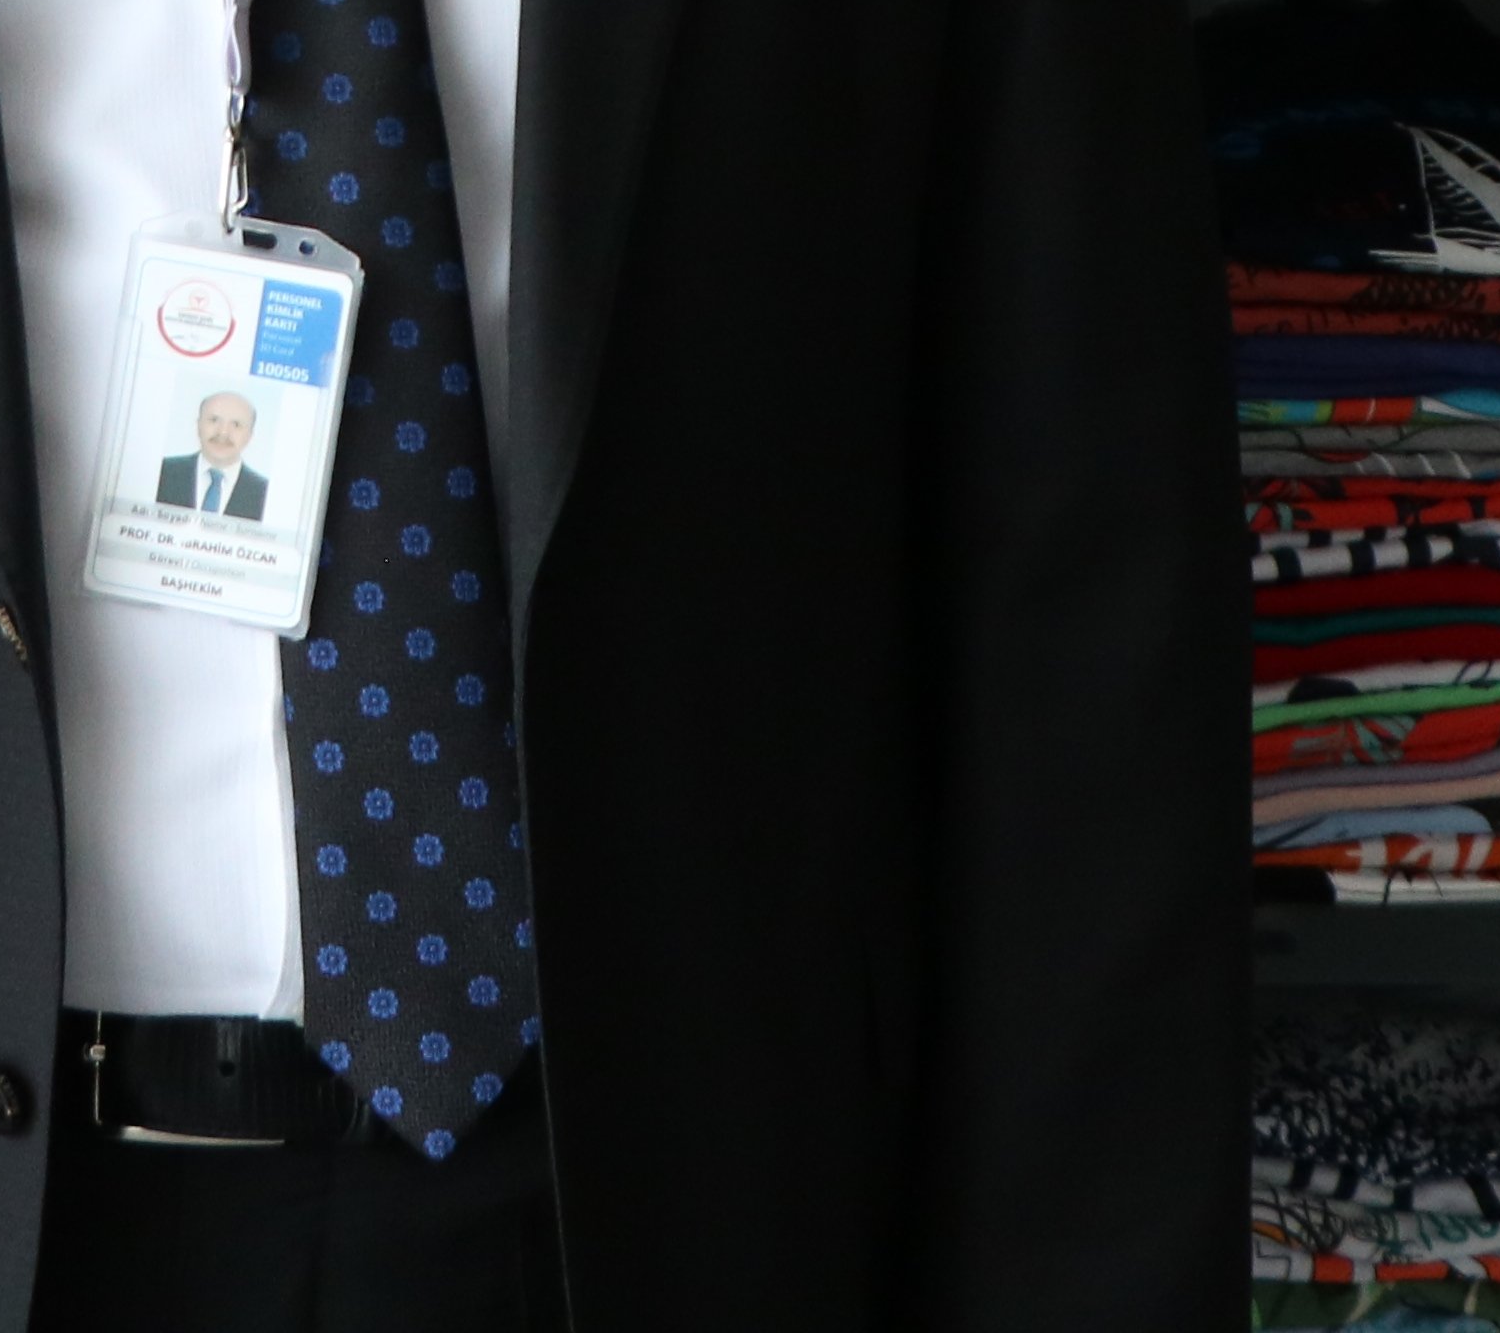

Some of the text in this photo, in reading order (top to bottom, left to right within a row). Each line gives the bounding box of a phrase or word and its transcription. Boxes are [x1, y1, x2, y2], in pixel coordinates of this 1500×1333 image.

[268, 290, 323, 310] PERSONEL
[266, 302, 304, 320] KİMLİK
[264, 316, 298, 333] KARTI
[257, 360, 311, 383] 100505
[119, 524, 155, 542] PROF.
[157, 533, 177, 546] DR.
[236, 545, 279, 566] ÖZCAN
[160, 575, 224, 597] BAŞHEKİM
